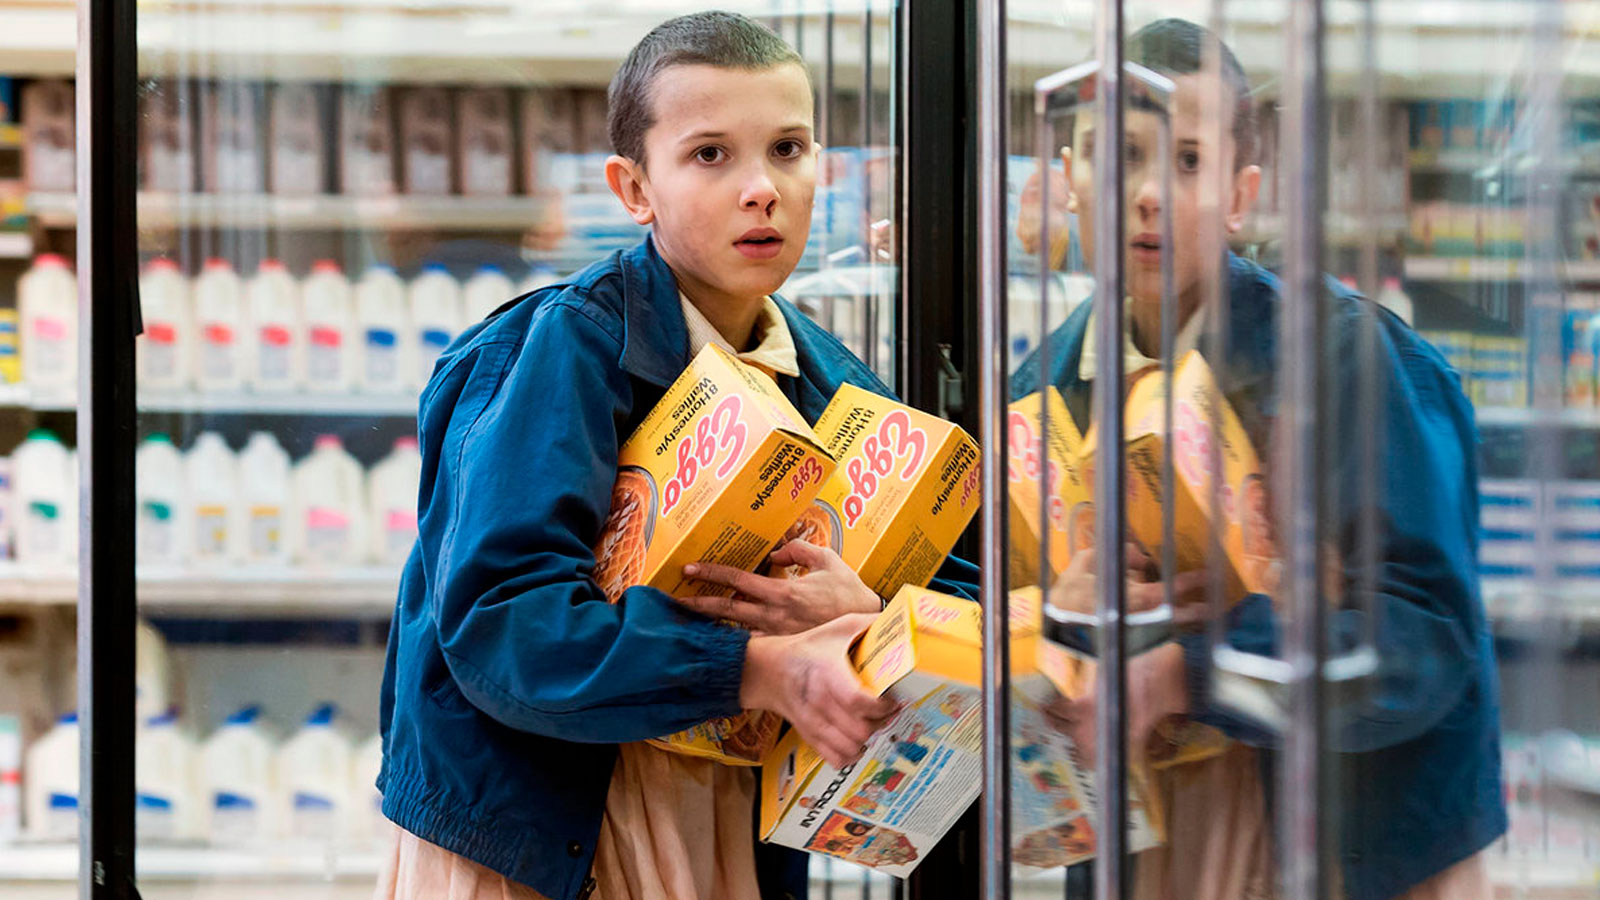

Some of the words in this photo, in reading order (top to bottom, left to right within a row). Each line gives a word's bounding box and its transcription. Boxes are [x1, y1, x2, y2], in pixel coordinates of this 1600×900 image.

[672, 377, 713, 420] Waffles
[709, 384, 718, 394] 8
[655, 392, 713, 456] Homestyle
[827, 407, 864, 450] Waffles
[863, 409, 875, 418] 8
[662, 394, 747, 516] Eggo
[759, 443, 796, 482] Waffles
[794, 447, 805, 456] 8
[844, 410, 926, 527] Eggo
[941, 443, 970, 482] Waffles
[968, 450, 976, 459] 8
[750, 455, 800, 511] Homestyle
[790, 456, 823, 501] Eggo
[931, 457, 972, 515] Homestyle
[800, 744, 868, 828] INTRODUC
